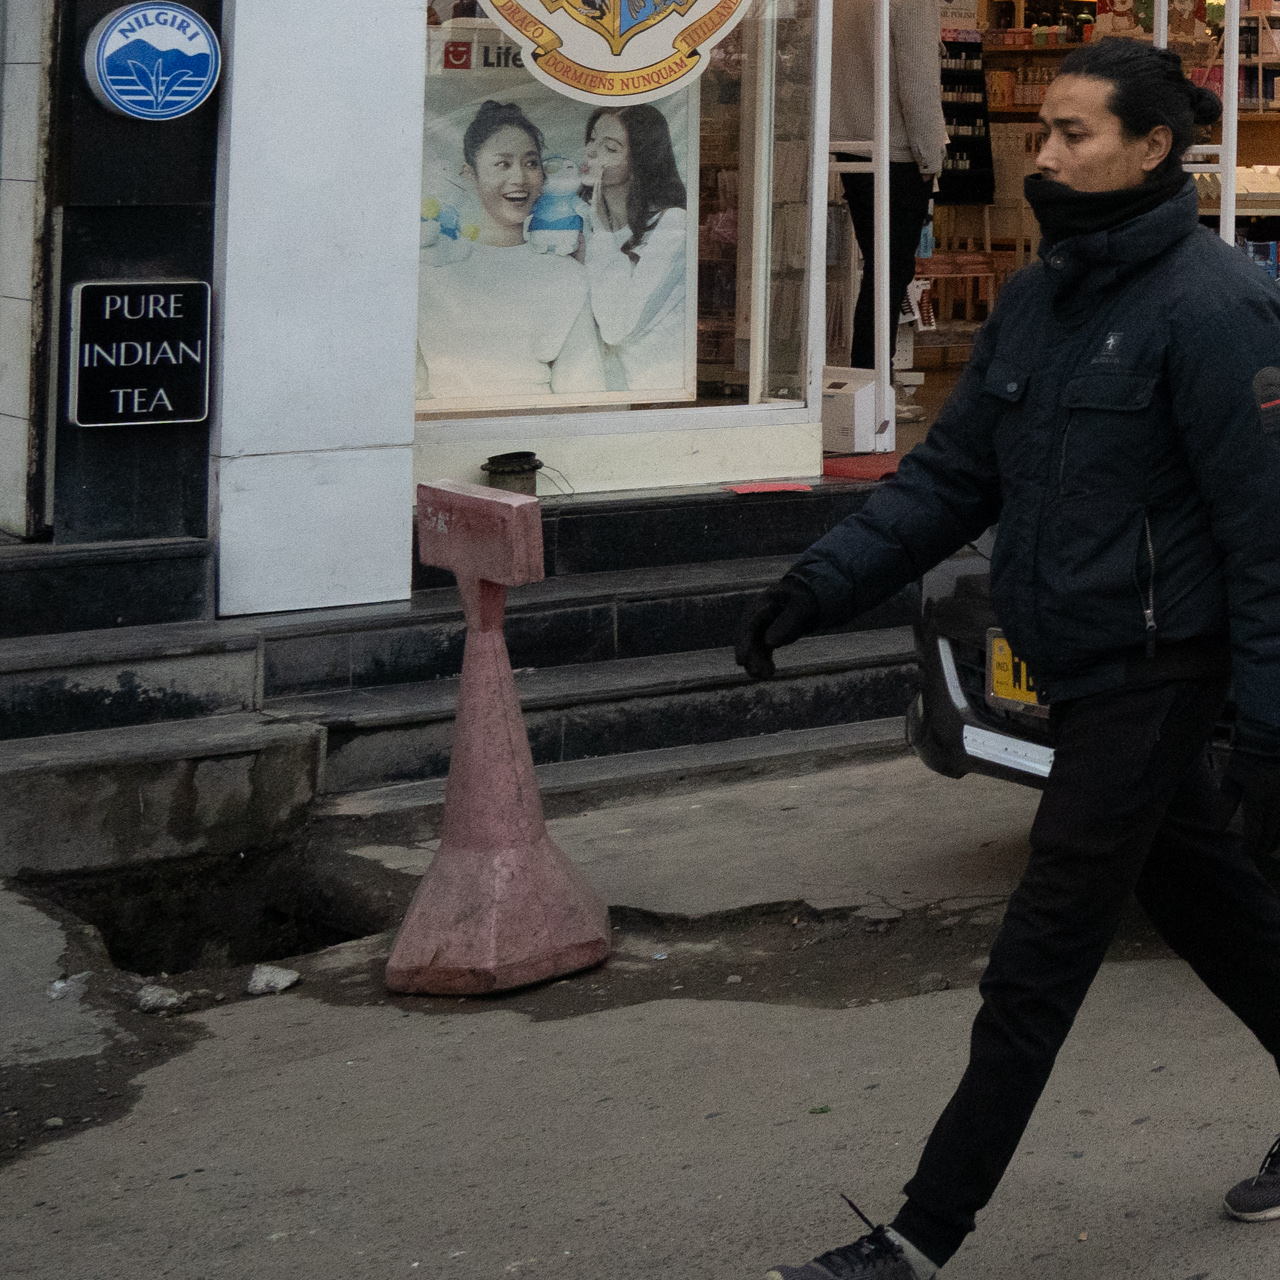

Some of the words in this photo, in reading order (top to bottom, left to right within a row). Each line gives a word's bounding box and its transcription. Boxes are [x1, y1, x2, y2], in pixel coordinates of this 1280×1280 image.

[118, 10, 201, 43] NILGIRI
[545, 54, 615, 92] DORMIENS
[619, 57, 689, 92] NUNQUAM
[104, 293, 184, 320] PURE
[83, 340, 202, 368] INDIAN
[109, 388, 174, 414] TEA
